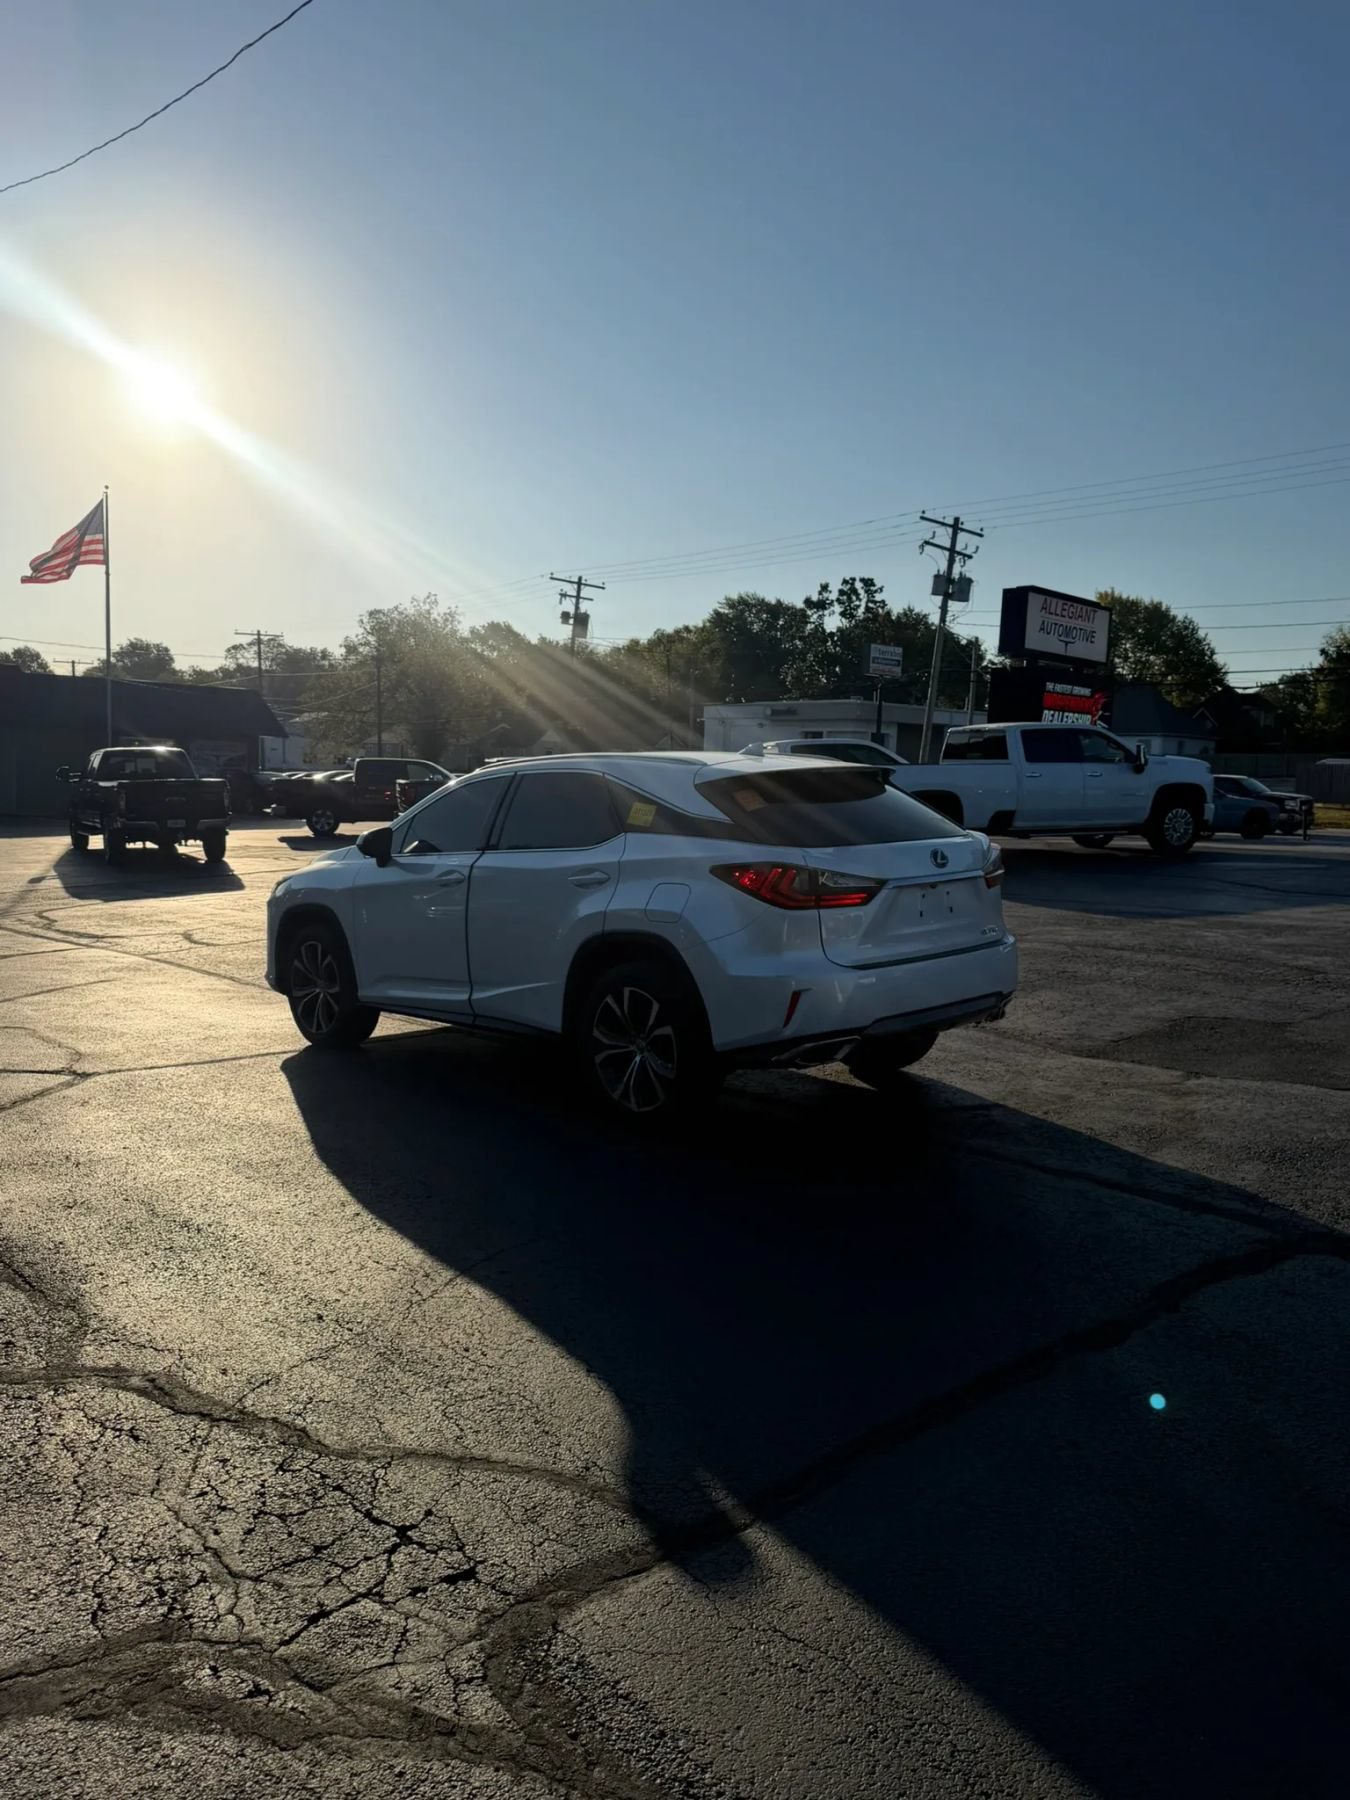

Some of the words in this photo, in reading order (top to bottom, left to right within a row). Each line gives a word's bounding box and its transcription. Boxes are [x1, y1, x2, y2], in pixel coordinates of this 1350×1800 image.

[1040, 597, 1098, 625] ALLEGIANT
[1038, 620, 1097, 644] AUTOMOTIVE
[1042, 710, 1092, 725] DEALERSHIP
